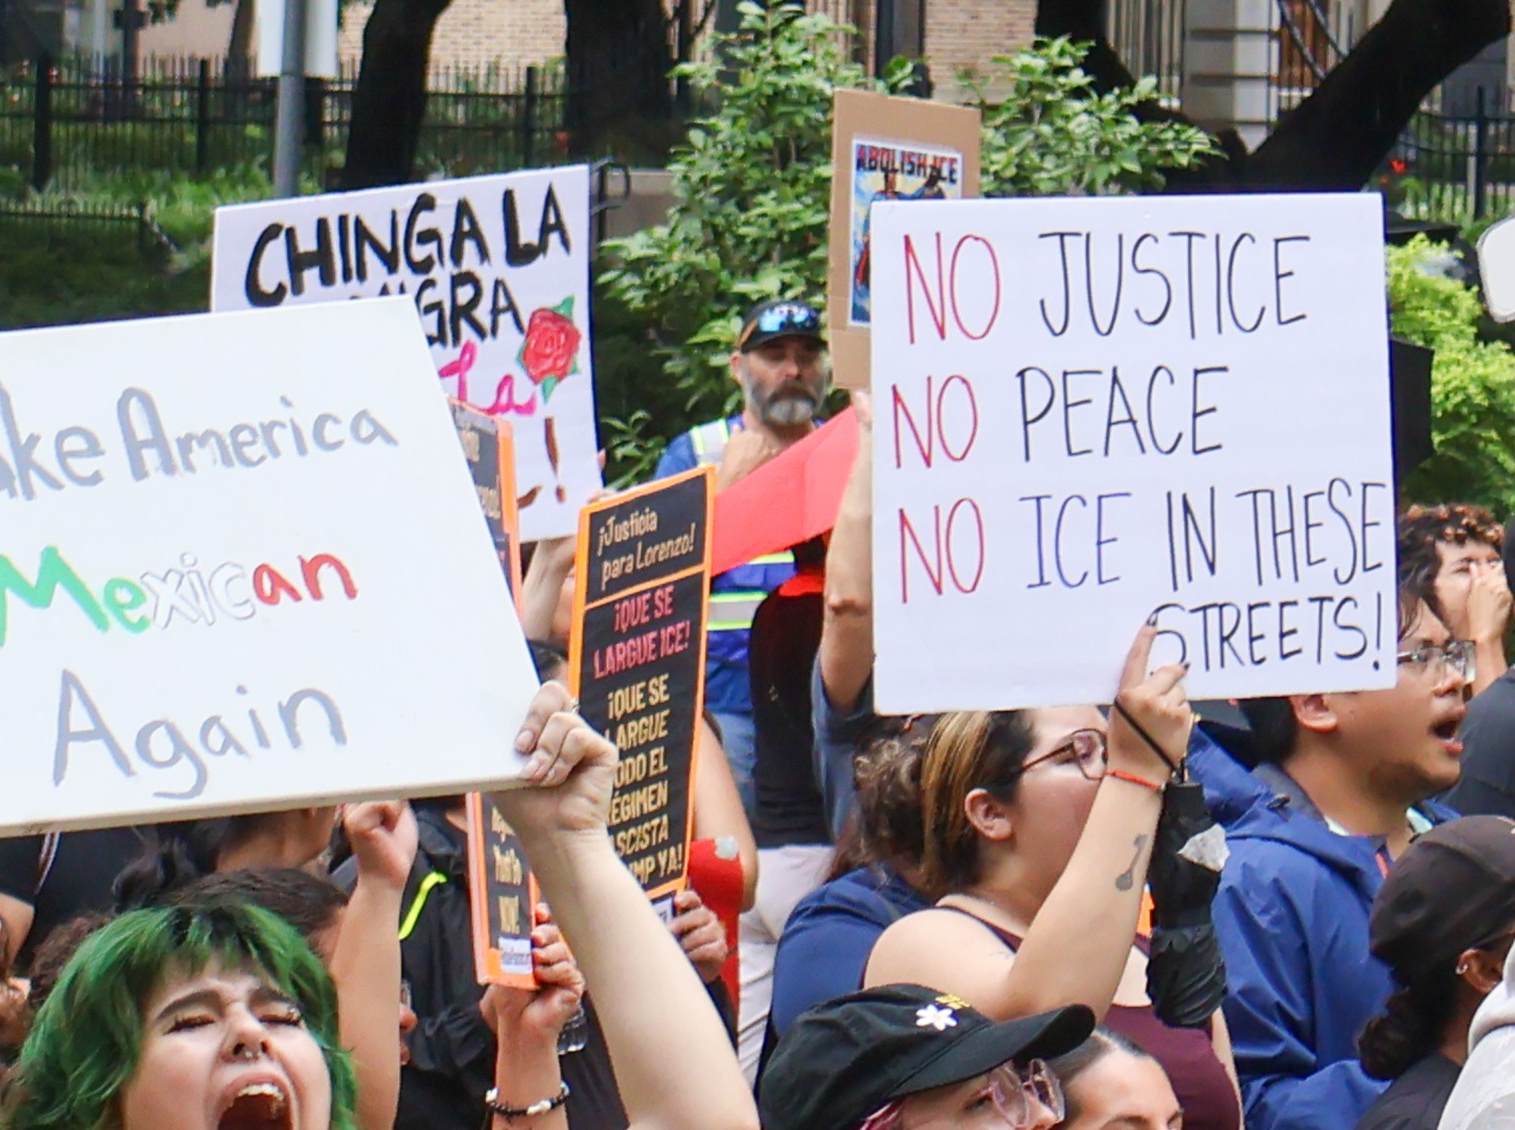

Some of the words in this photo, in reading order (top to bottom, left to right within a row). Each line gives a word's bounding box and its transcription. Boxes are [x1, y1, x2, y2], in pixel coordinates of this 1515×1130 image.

[856, 144, 928, 178] ABOLISH
[244, 190, 492, 308] CHINGA
[502, 180, 573, 268] LA
[903, 230, 1002, 345] NO
[1037, 230, 1312, 341] JUSTICE
[115, 385, 400, 483] America
[890, 372, 979, 470] NO
[1014, 363, 1231, 463] PEACE
[602, 557, 633, 590] para
[637, 523, 695, 569] Lorenzo!
[897, 496, 986, 605] NO
[1018, 491, 1133, 591] ICE
[1165, 484, 1218, 593] IN
[1235, 476, 1388, 587] THESE
[654, 585, 674, 619] SE
[1148, 590, 1384, 673] STREETS!
[594, 633, 657, 678] LARGUE
[659, 621, 690, 659] ICE!
[649, 673, 669, 705] SE
[51, 668, 348, 801] Again
[615, 753, 646, 788] ODO
[650, 746, 668, 777] EL
[608, 780, 668, 826] ÉGIMEN
[616, 814, 668, 856] SCISTA
[658, 844, 683, 878] YA!
